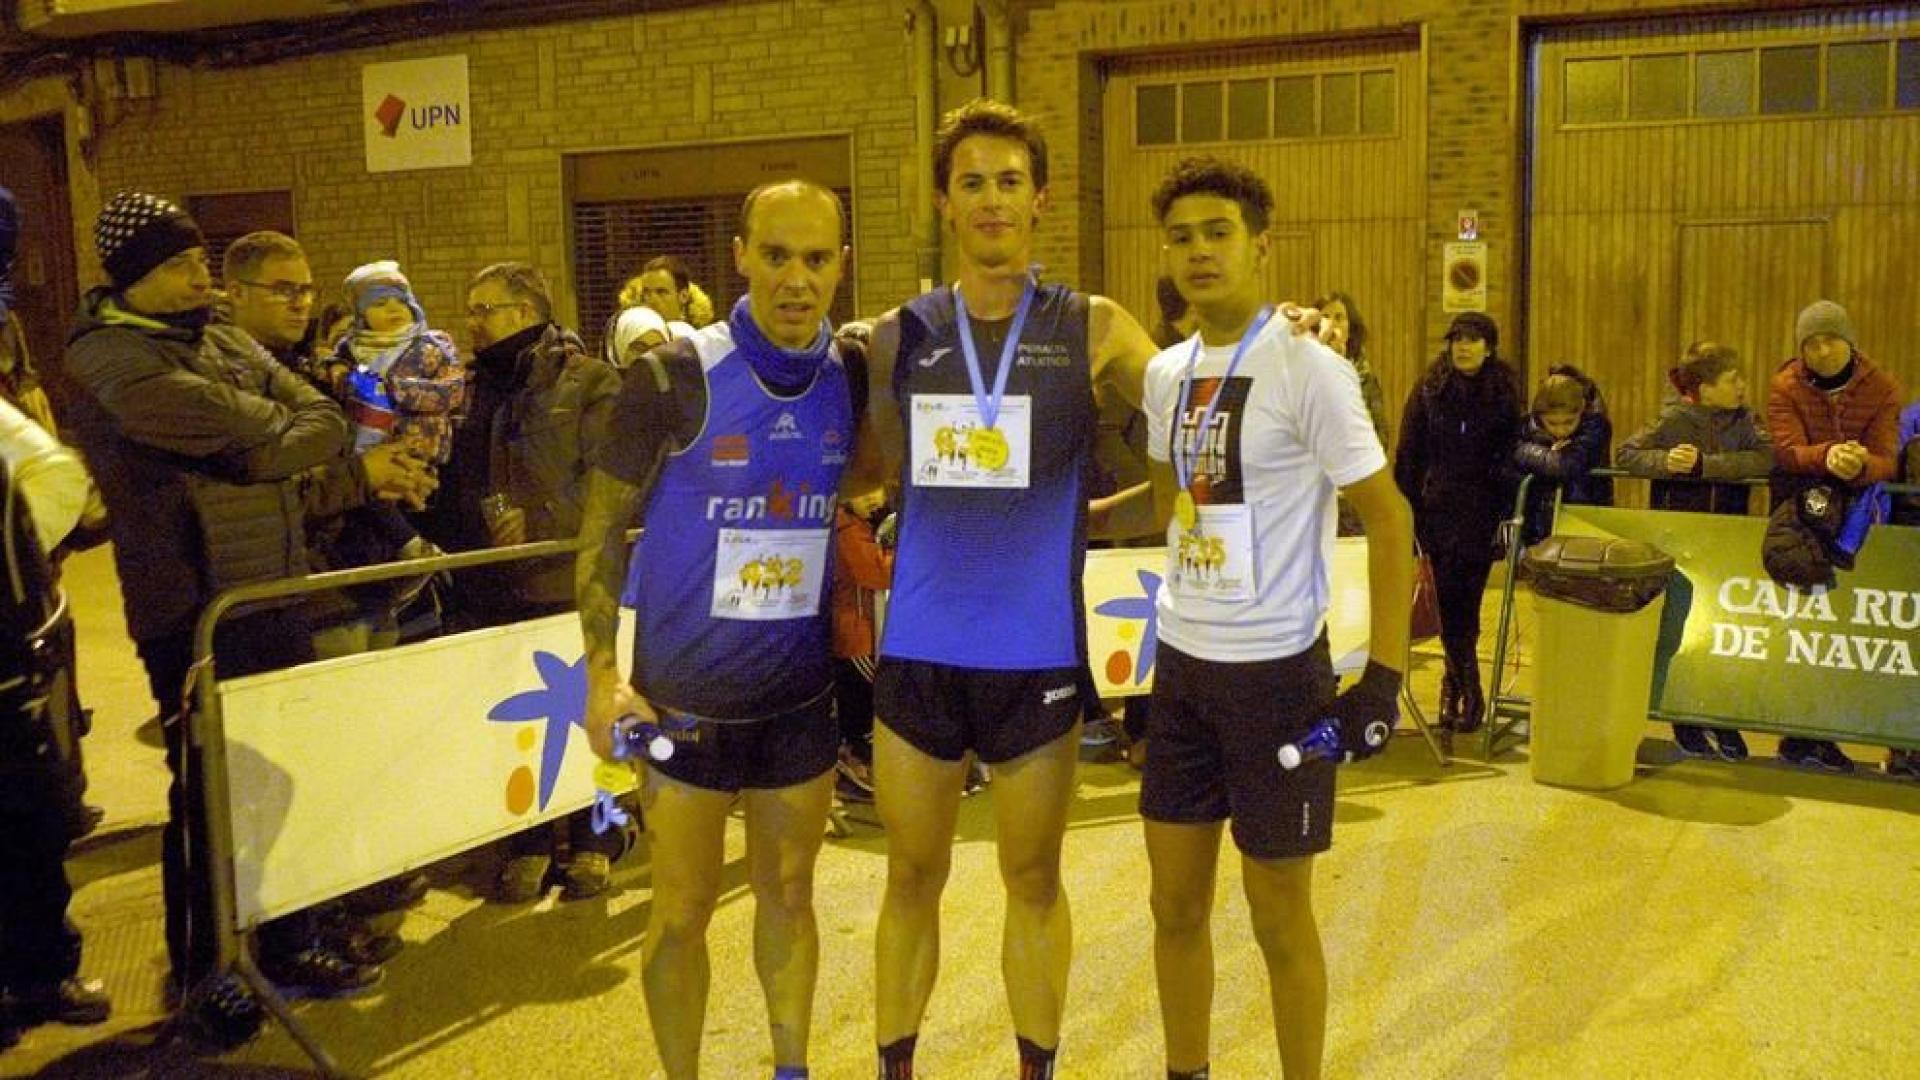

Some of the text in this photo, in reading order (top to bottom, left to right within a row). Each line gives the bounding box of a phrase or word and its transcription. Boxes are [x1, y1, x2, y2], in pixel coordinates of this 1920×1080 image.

[411, 103, 460, 130] UPN
[1719, 576, 1920, 629] CAJA RU
[1710, 623, 1919, 675] DE NAVA
